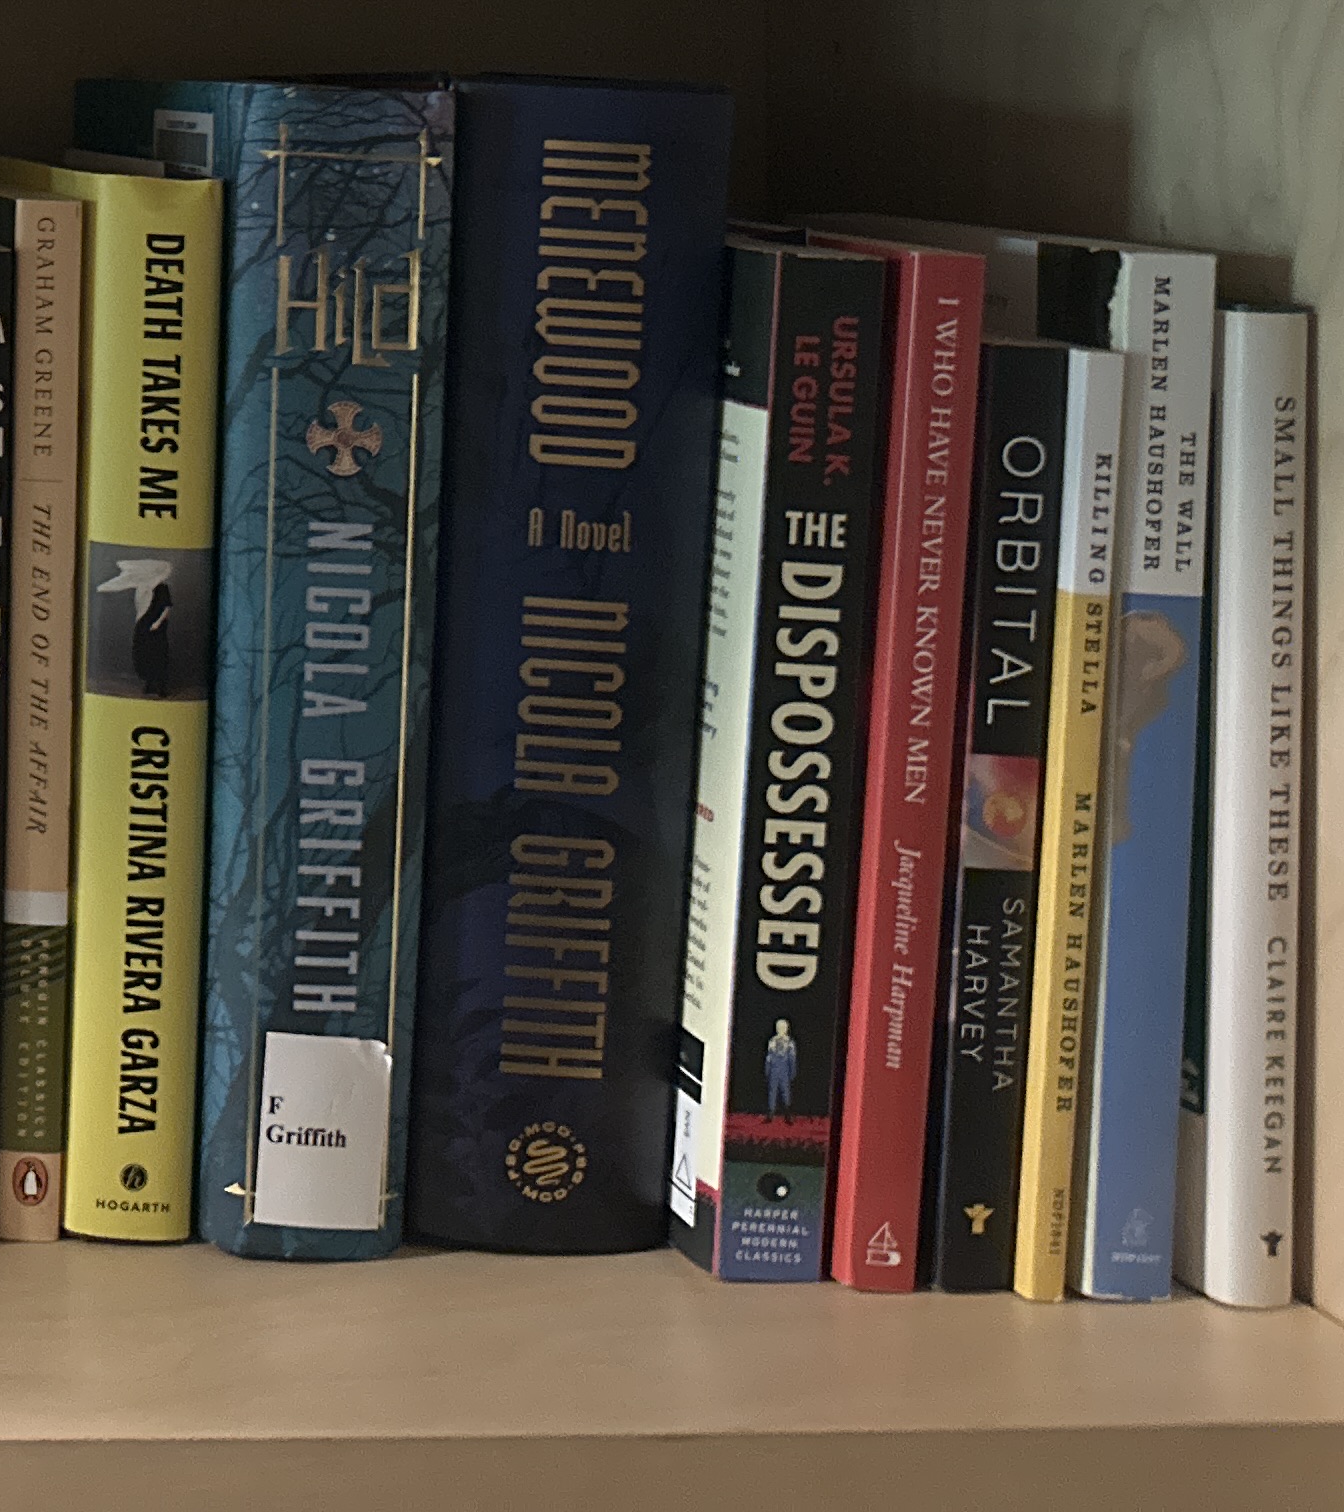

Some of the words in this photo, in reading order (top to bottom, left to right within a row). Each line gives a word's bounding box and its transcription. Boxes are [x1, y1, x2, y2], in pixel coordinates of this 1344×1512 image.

[140, 232, 186, 339] DEATH
[138, 356, 184, 453] TAKES
[791, 336, 819, 366] LE
[826, 316, 856, 442] URSULA
[787, 379, 817, 462] GUIN
[822, 453, 850, 486] K.
[1271, 396, 1296, 516] SMALL
[136, 468, 180, 519] ME
[784, 511, 848, 548] THE
[302, 521, 372, 716] NICOLA
[984, 436, 1045, 726] ORBITAL
[1270, 531, 1294, 670] THINGS
[754, 558, 843, 991] DISPOSSESSED
[1268, 684, 1293, 769] LIKE
[125, 725, 170, 880] CRISTINA
[1266, 785, 1291, 903] THESE
[292, 757, 365, 1012] GRIFFITH
[120, 896, 166, 1014] RIVERA
[956, 923, 990, 1065] HARVEY
[988, 898, 1024, 1092] SAMANTHA
[1265, 937, 1285, 1040] CLAIRE
[115, 1028, 161, 1136] GARZA
[265, 1097, 280, 1113] F
[265, 1124, 346, 1149] Griffith
[1262, 1053, 1283, 1175] KEEGAN
[94, 1198, 170, 1212] HOGARTH
